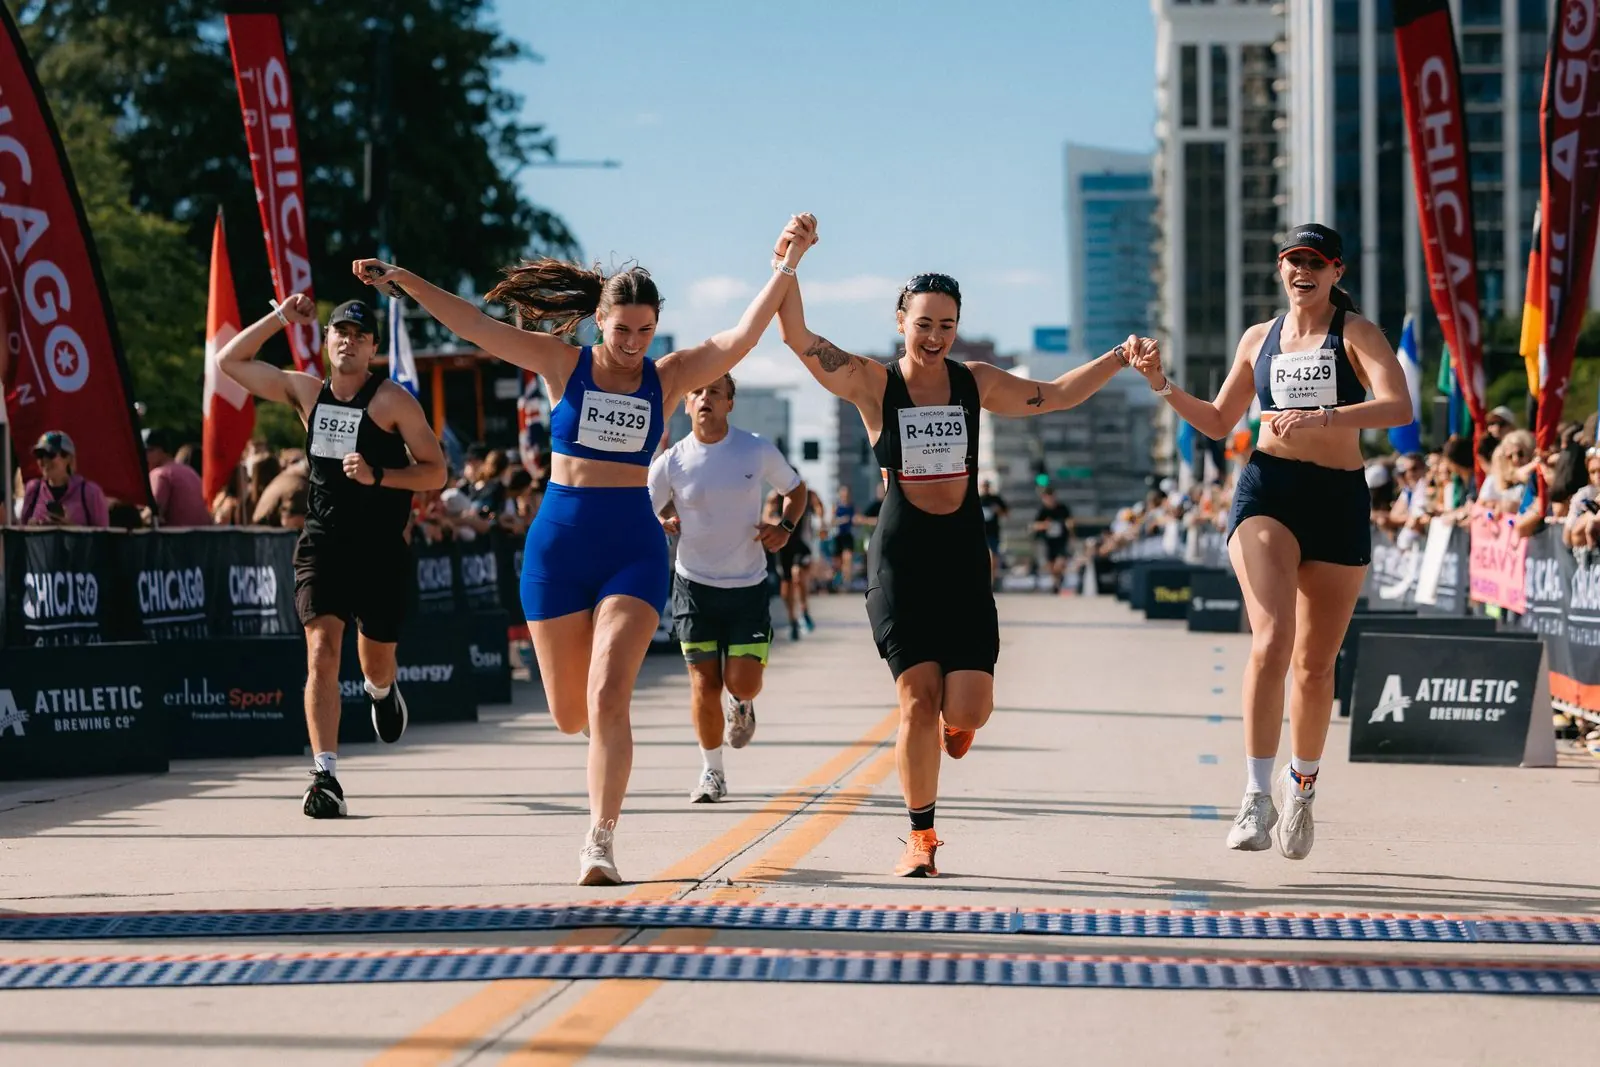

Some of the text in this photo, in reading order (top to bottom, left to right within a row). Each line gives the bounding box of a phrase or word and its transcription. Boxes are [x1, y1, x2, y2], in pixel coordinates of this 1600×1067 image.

[1276, 365, 1331, 383] R-4329
[604, 398, 631, 406] CHICAGO
[319, 417, 356, 434] 5923
[587, 407, 646, 430] R-4329
[906, 421, 962, 440] R-4329
[598, 435, 627, 445] OLYMPIC
[922, 447, 951, 455] OLYMPIC
[138, 566, 205, 613] CHICAGO
[397, 664, 454, 682] nergy
[35, 686, 143, 714] ATHLETIC
[229, 688, 284, 710] Sport
[1415, 678, 1519, 704] ATHLETIC
[1429, 707, 1483, 721] BREWING
[54, 717, 111, 732] BREWING
